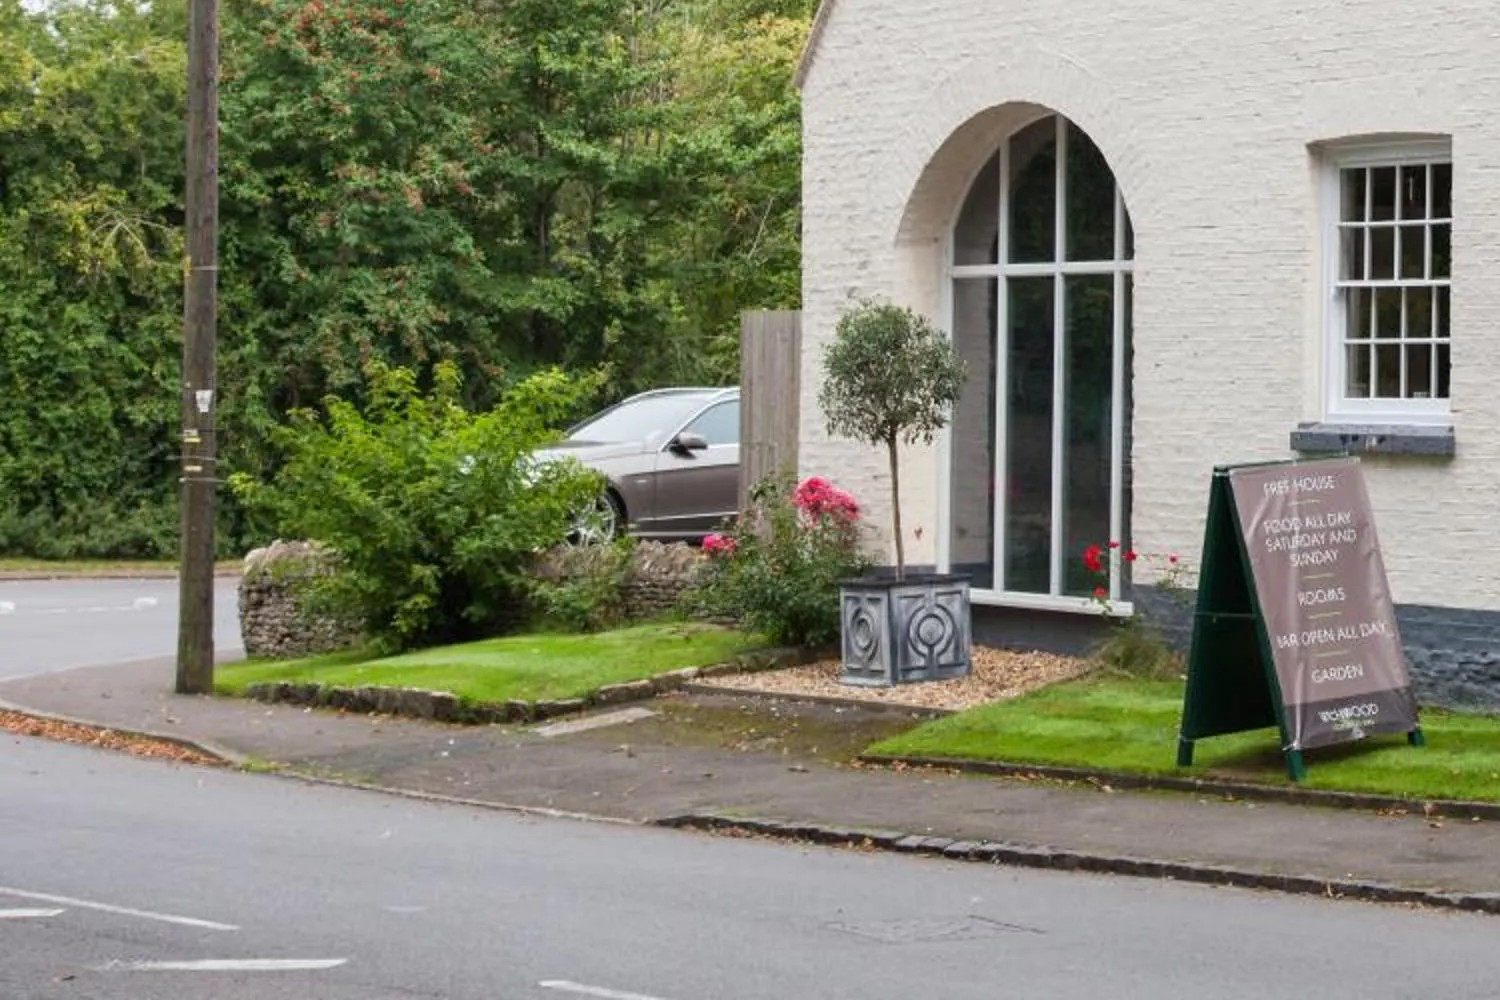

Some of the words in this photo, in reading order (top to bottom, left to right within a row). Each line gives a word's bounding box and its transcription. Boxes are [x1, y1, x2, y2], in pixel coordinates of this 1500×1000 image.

[1264, 482, 1289, 496] FREE
[1292, 475, 1336, 492] HOUSE
[1264, 517, 1301, 534] FOOD
[1304, 515, 1325, 529] ALL
[1326, 511, 1351, 526] DAY
[1265, 534, 1326, 553] SATURDAY
[1328, 529, 1358, 545] AND
[1289, 549, 1339, 567] SUNDAY
[1297, 587, 1345, 606] ROOMS
[1301, 628, 1335, 646] OPEN
[1337, 626, 1359, 641] ALL
[1359, 622, 1387, 638] DAY
[1311, 664, 1364, 684] GARDEN
